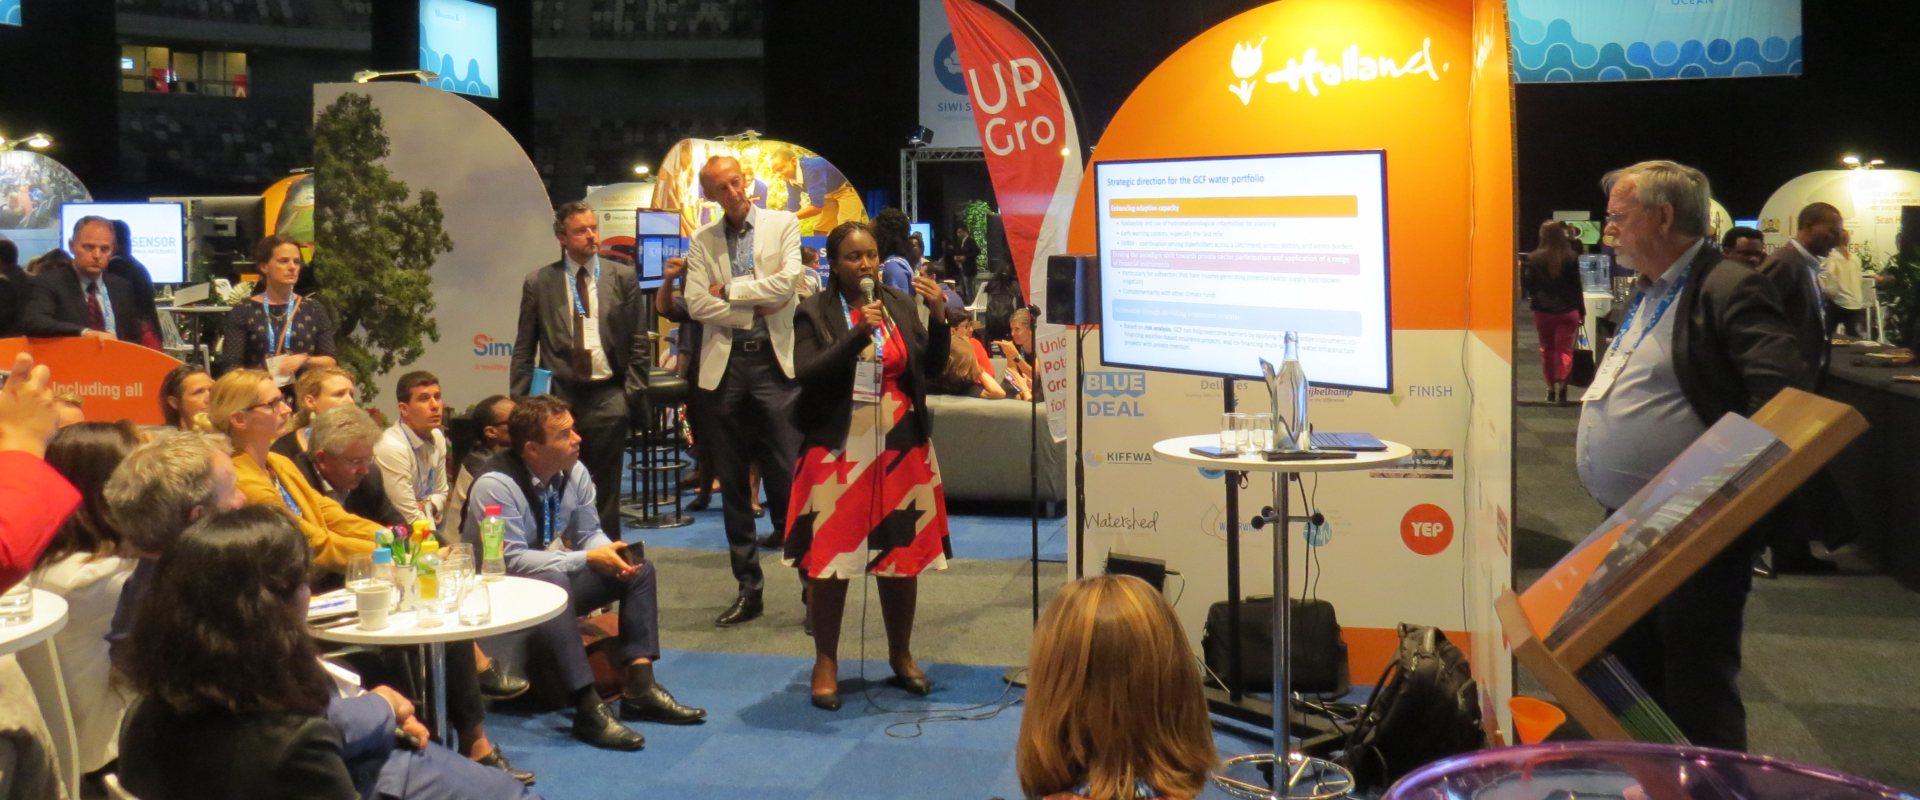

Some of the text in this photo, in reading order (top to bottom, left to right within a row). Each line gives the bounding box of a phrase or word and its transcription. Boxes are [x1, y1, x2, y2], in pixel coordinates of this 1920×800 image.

[968, 57, 1043, 115] UP
[937, 102, 963, 112] SIWI
[985, 116, 1056, 156] Gro
[1107, 173, 1264, 187] Strategic direction for the GCF water portfolio
[132, 236, 176, 248] SENSOR
[473, 333, 513, 357] Sim
[1039, 336, 1067, 354] Unlo
[1044, 360, 1067, 374] Pot
[1086, 374, 1143, 391] BLUE
[1201, 379, 1248, 391] Deles
[53, 381, 143, 400] Including all
[1308, 387, 1354, 399] ijkelkamp
[1409, 385, 1453, 398] FINISH
[1050, 399, 1067, 413] for
[1086, 401, 1144, 417] DEAL
[1107, 452, 1153, 462] KIFFWA
[1084, 507, 1159, 533] Watershed
[1411, 521, 1444, 537] YEP
